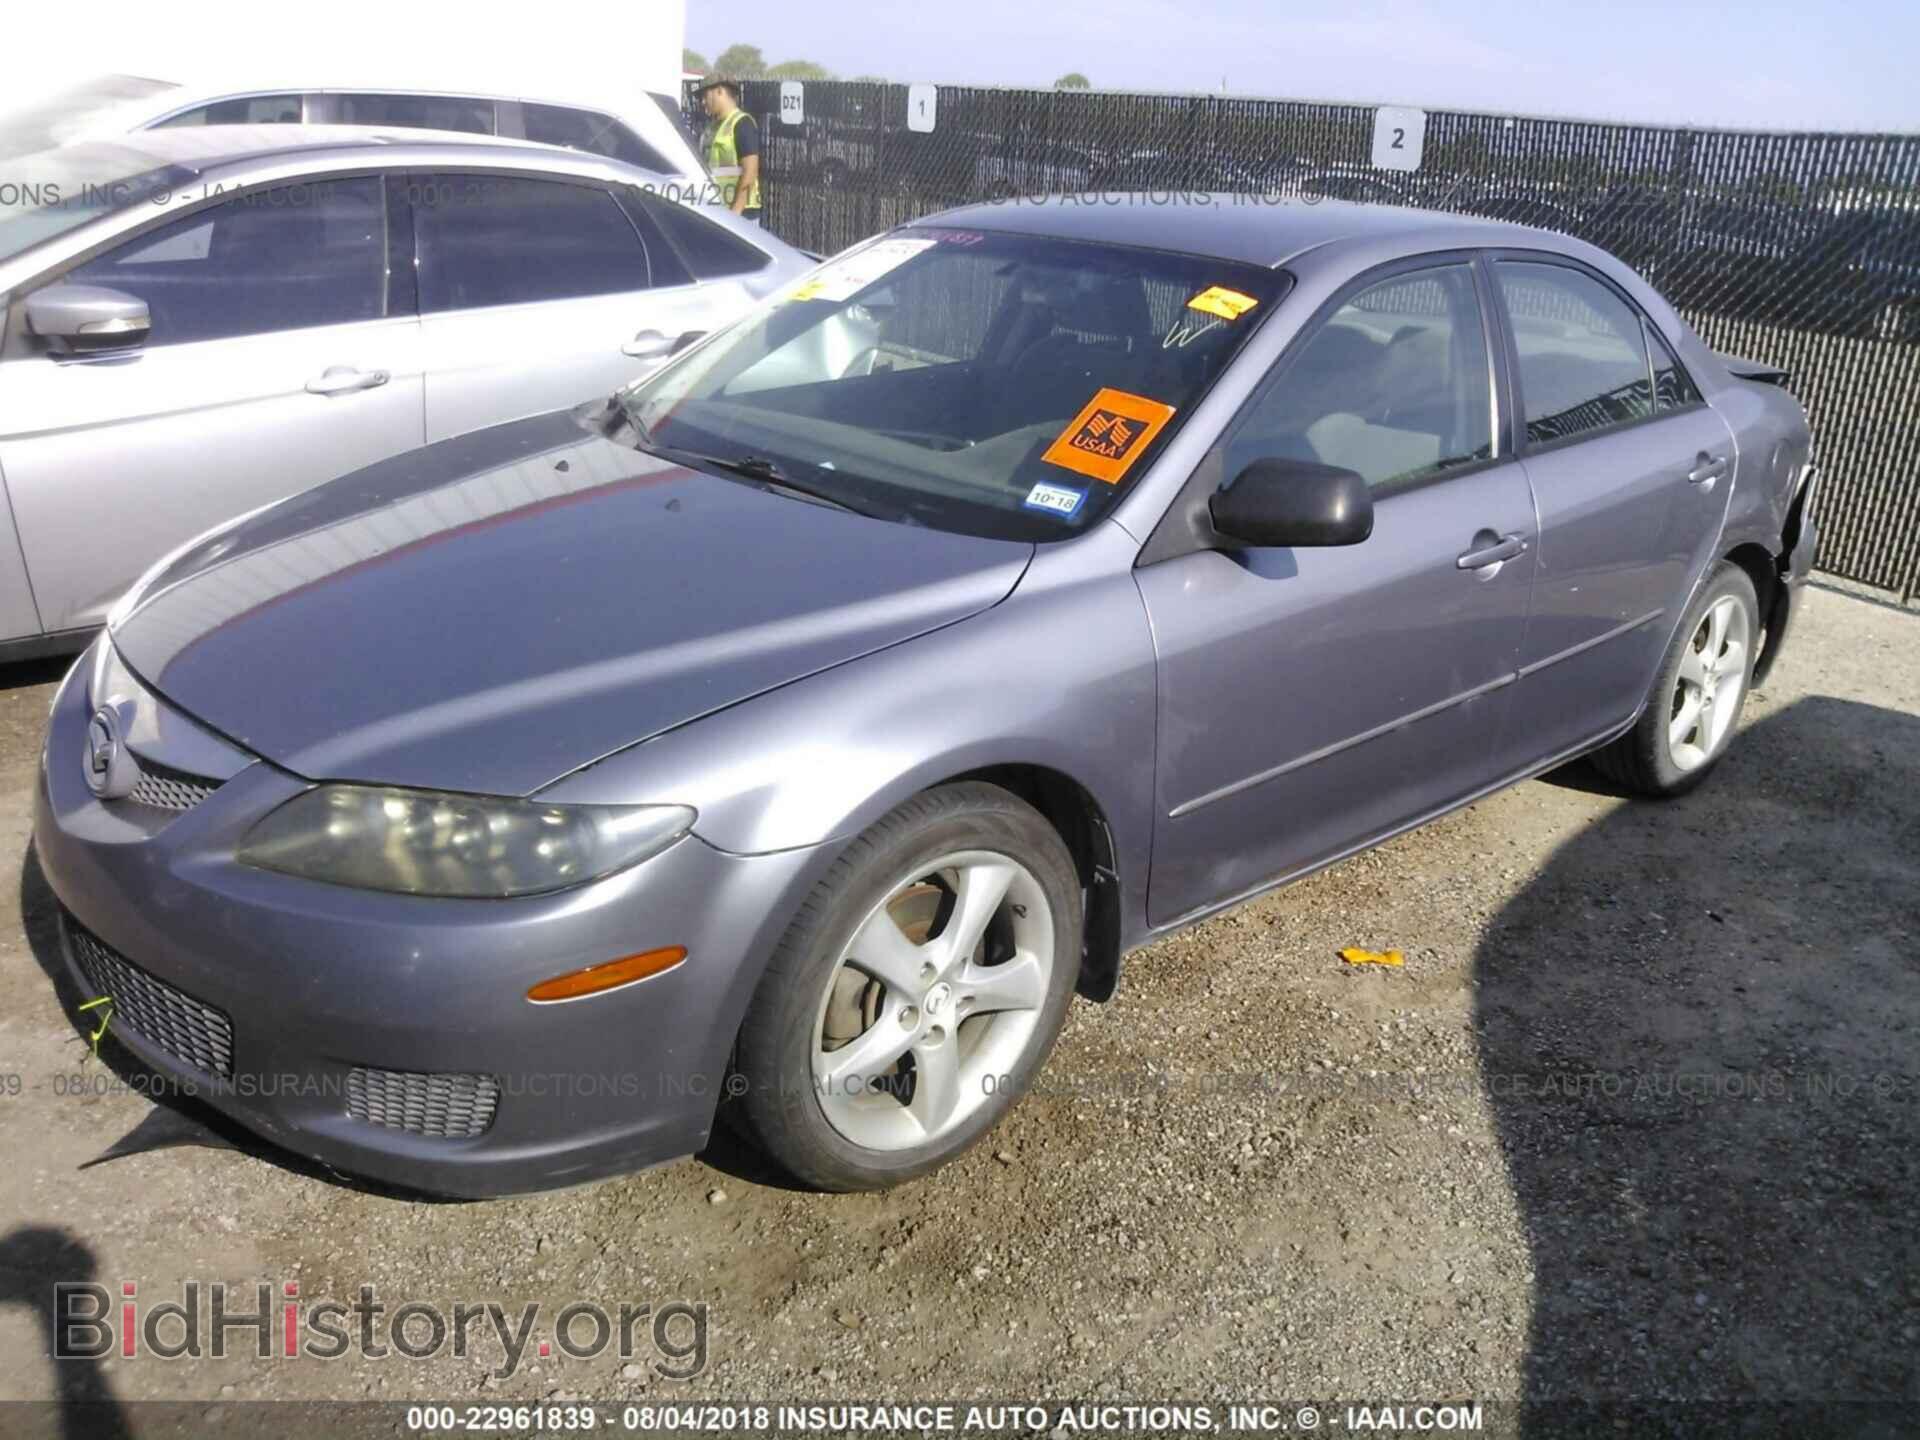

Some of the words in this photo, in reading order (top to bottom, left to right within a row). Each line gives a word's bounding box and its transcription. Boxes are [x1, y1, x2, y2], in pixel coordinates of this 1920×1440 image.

[783, 95, 801, 110] DZ1
[919, 100, 927, 117] 1
[1391, 127, 1405, 149] 2
[1074, 434, 1116, 457] USAA
